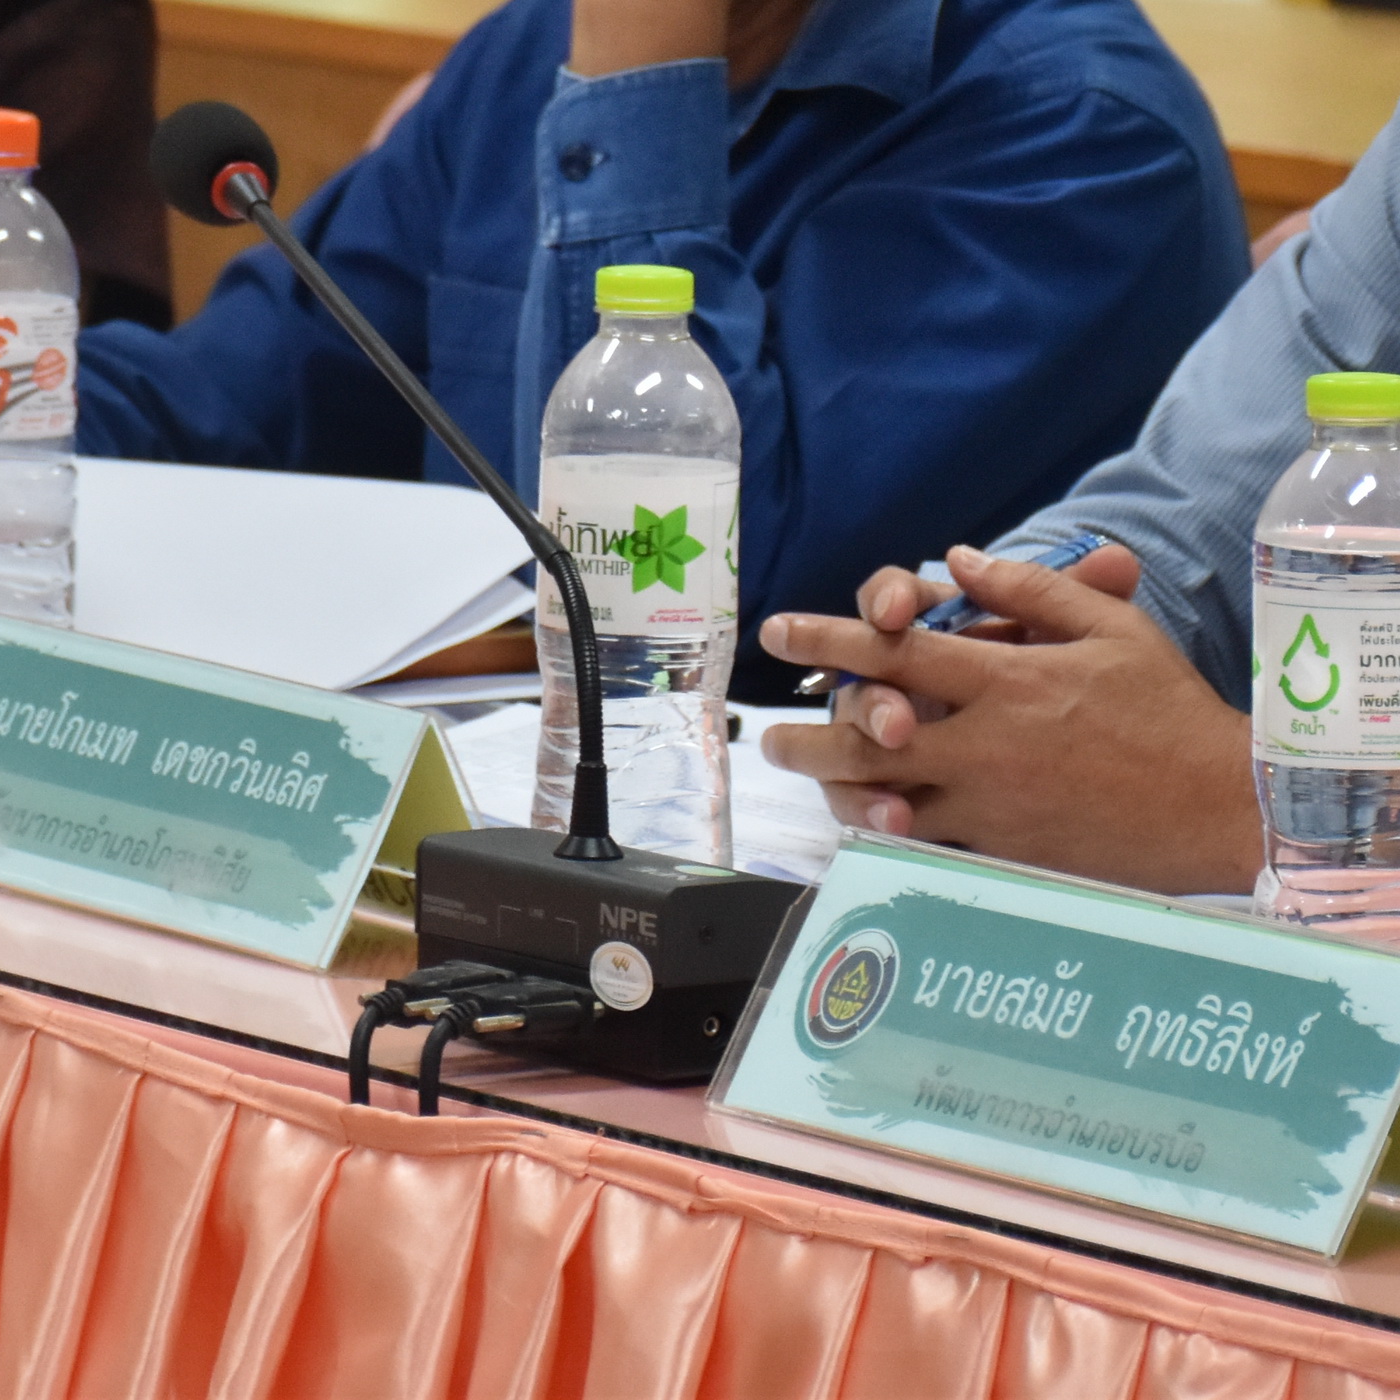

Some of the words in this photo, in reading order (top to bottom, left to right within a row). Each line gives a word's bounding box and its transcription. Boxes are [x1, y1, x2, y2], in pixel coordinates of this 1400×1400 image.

[1290, 715, 1327, 737] รักน้ำ
[151, 737, 328, 813] เดชกวินเลิศ
[600, 902, 659, 938] NPE
[912, 958, 1094, 1040] นายสมัย
[1115, 993, 1323, 1089] ฤทธิสิงห์
